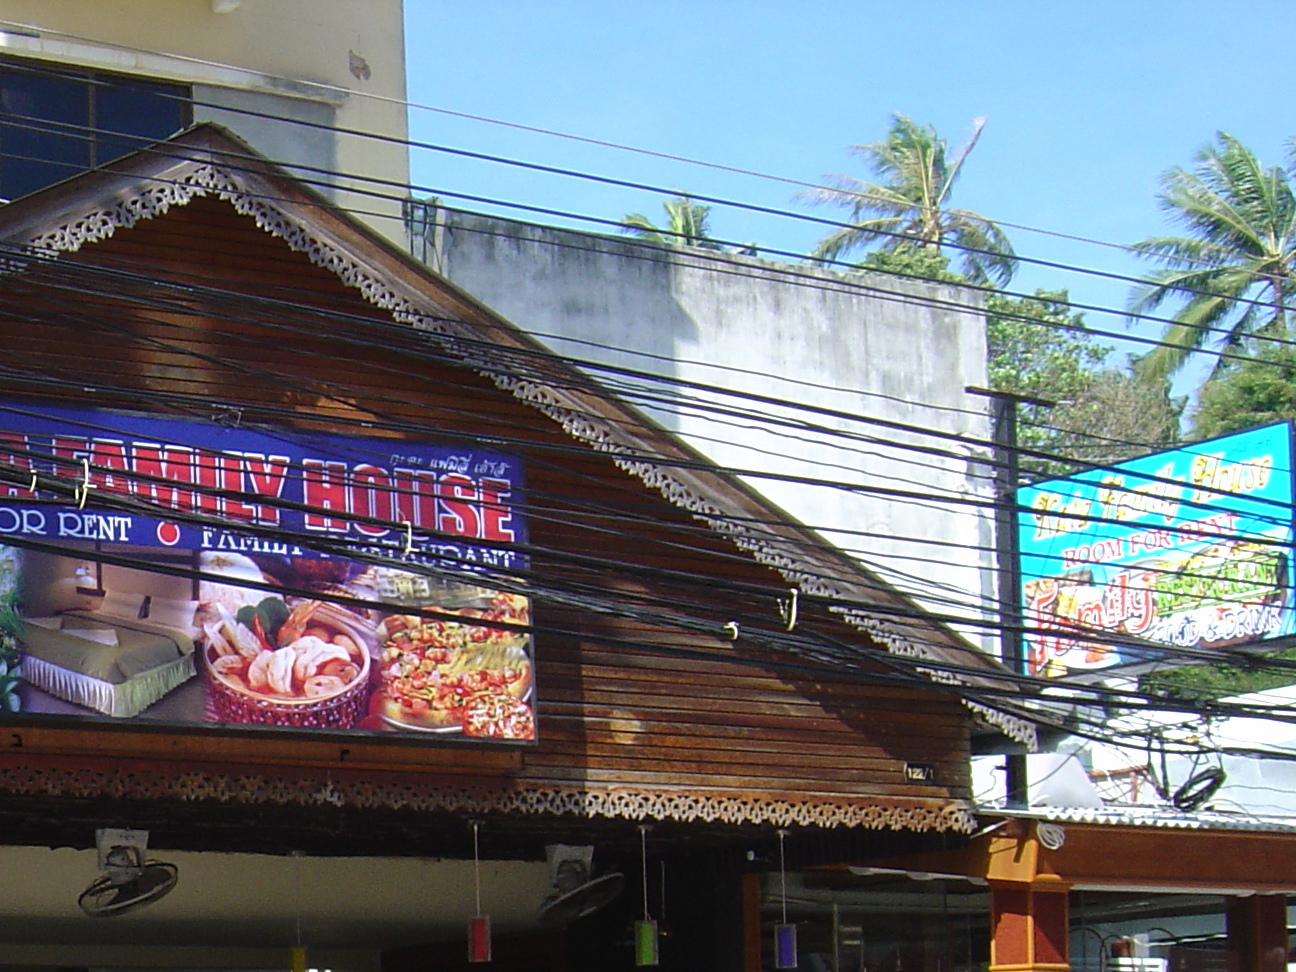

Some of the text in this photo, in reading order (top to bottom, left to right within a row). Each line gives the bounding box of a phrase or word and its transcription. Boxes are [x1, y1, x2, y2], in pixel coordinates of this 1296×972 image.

[52, 434, 291, 526] FAMILY
[302, 458, 515, 545] HOUSE
[1192, 452, 1273, 501] House
[57, 511, 132, 542] RENT
[1065, 512, 1236, 568] ROOM FOR RENT
